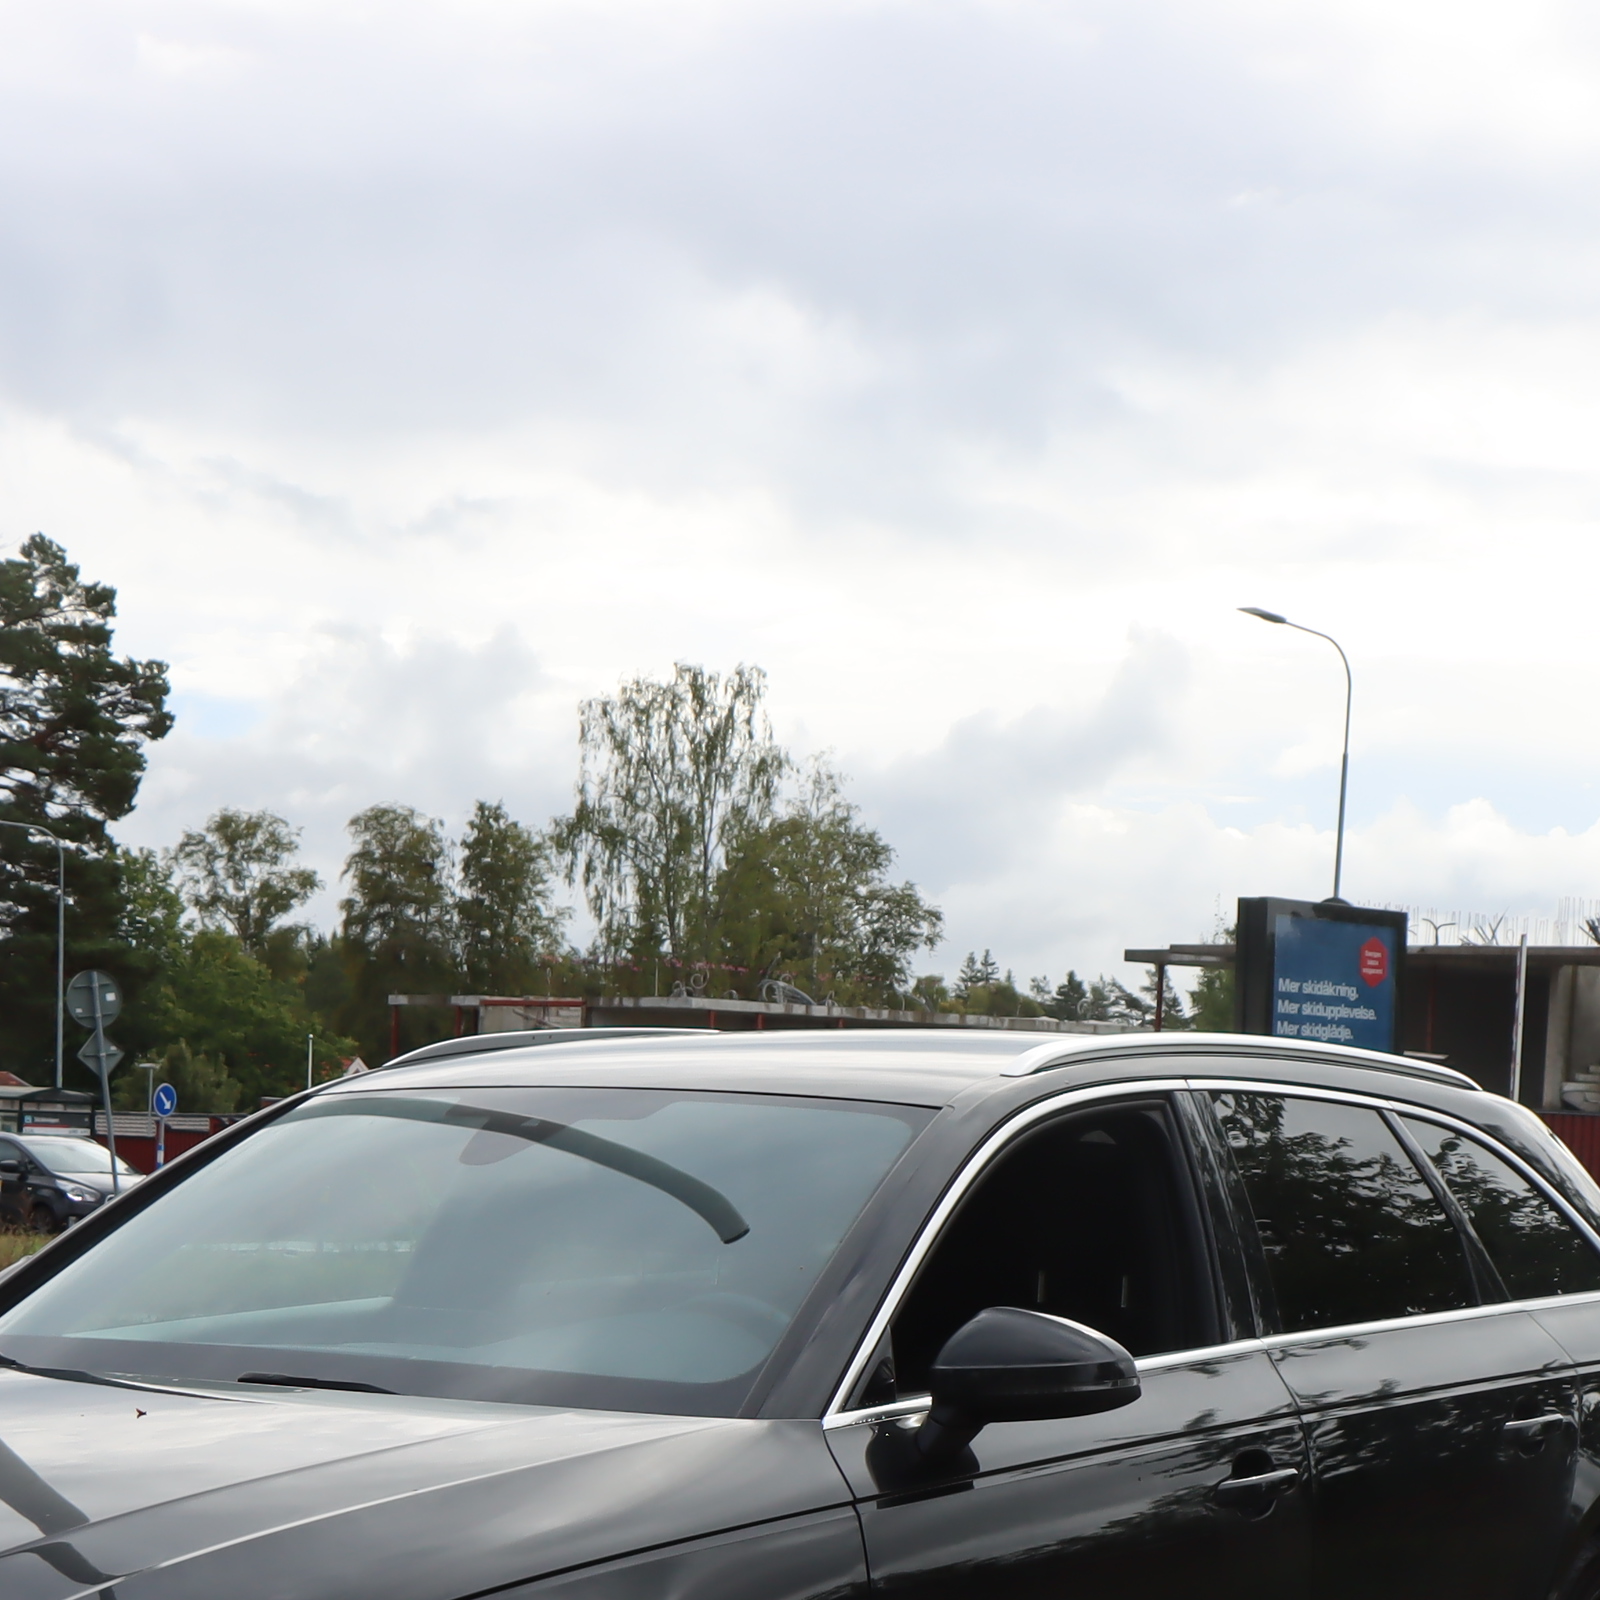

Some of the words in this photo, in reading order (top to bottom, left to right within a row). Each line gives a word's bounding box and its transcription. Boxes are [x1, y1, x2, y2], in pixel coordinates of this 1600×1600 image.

[1278, 978, 1300, 993] Mer
[1277, 999, 1300, 1014] Mer
[1301, 1001, 1377, 1020] skidupplevelse.
[1276, 1020, 1299, 1035] Mer
[1300, 1022, 1354, 1042] skidglädje.
